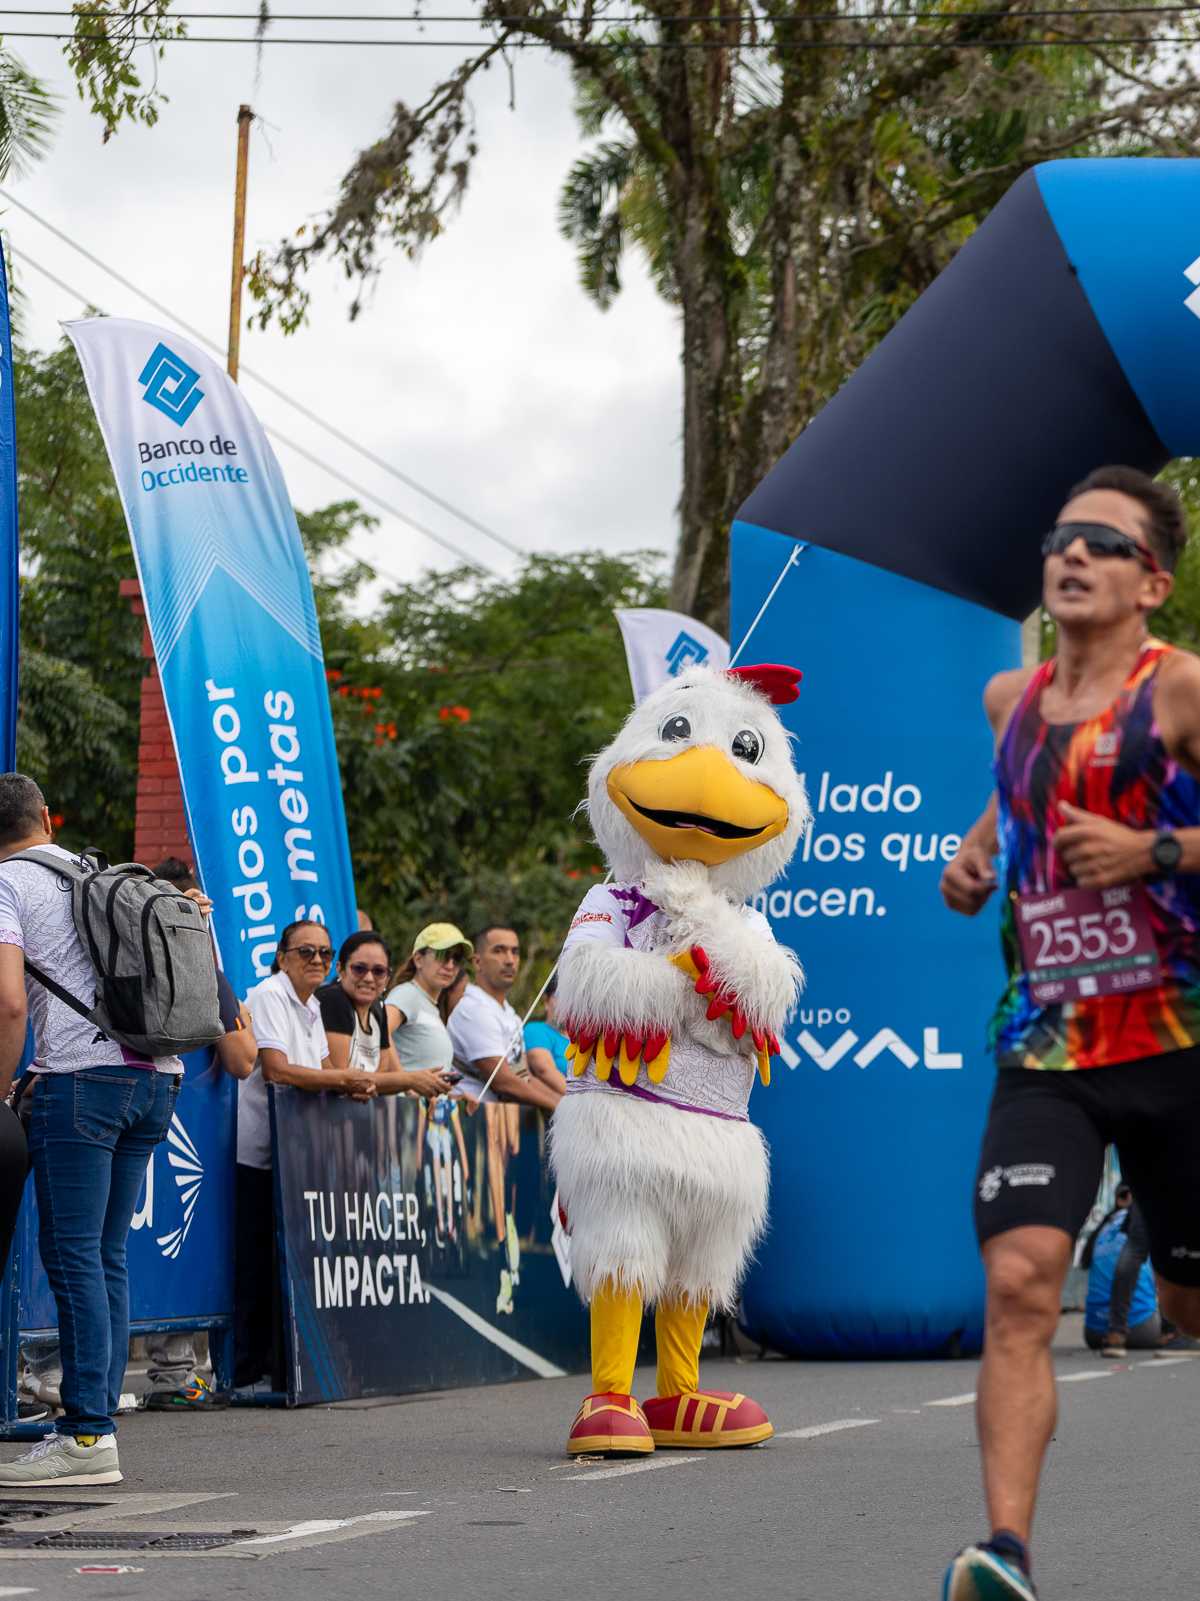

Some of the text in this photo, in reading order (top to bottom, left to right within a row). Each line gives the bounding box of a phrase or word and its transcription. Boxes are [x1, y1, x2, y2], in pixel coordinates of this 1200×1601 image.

[138, 435, 237, 464] Banco de
[141, 462, 249, 492] Occidente
[205, 679, 260, 786] por
[264, 690, 320, 883] metas
[817, 771, 922, 813] lado
[802, 821, 962, 872] los que
[232, 805, 279, 988] nidos
[1029, 909, 1137, 967] 2553
[788, 1007, 851, 1029] rupo
[304, 1191, 426, 1248] TU HACER,
[313, 1255, 430, 1310] IMPACTA.
